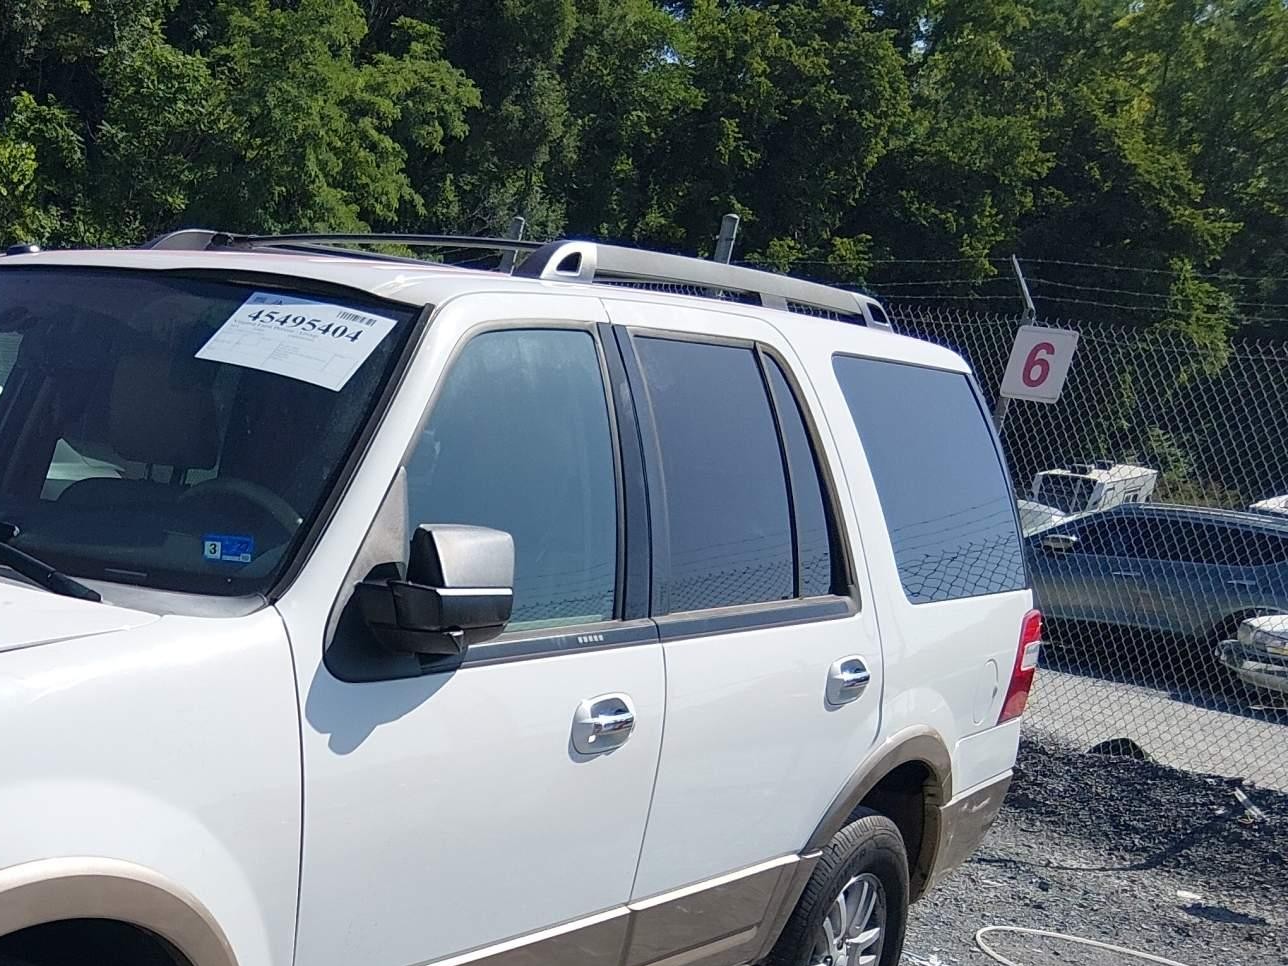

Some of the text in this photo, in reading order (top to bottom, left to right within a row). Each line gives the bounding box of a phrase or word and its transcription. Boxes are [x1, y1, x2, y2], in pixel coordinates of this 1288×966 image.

[248, 309, 363, 342] 45495404
[1022, 342, 1055, 388] 6
[209, 543, 217, 554] 3
